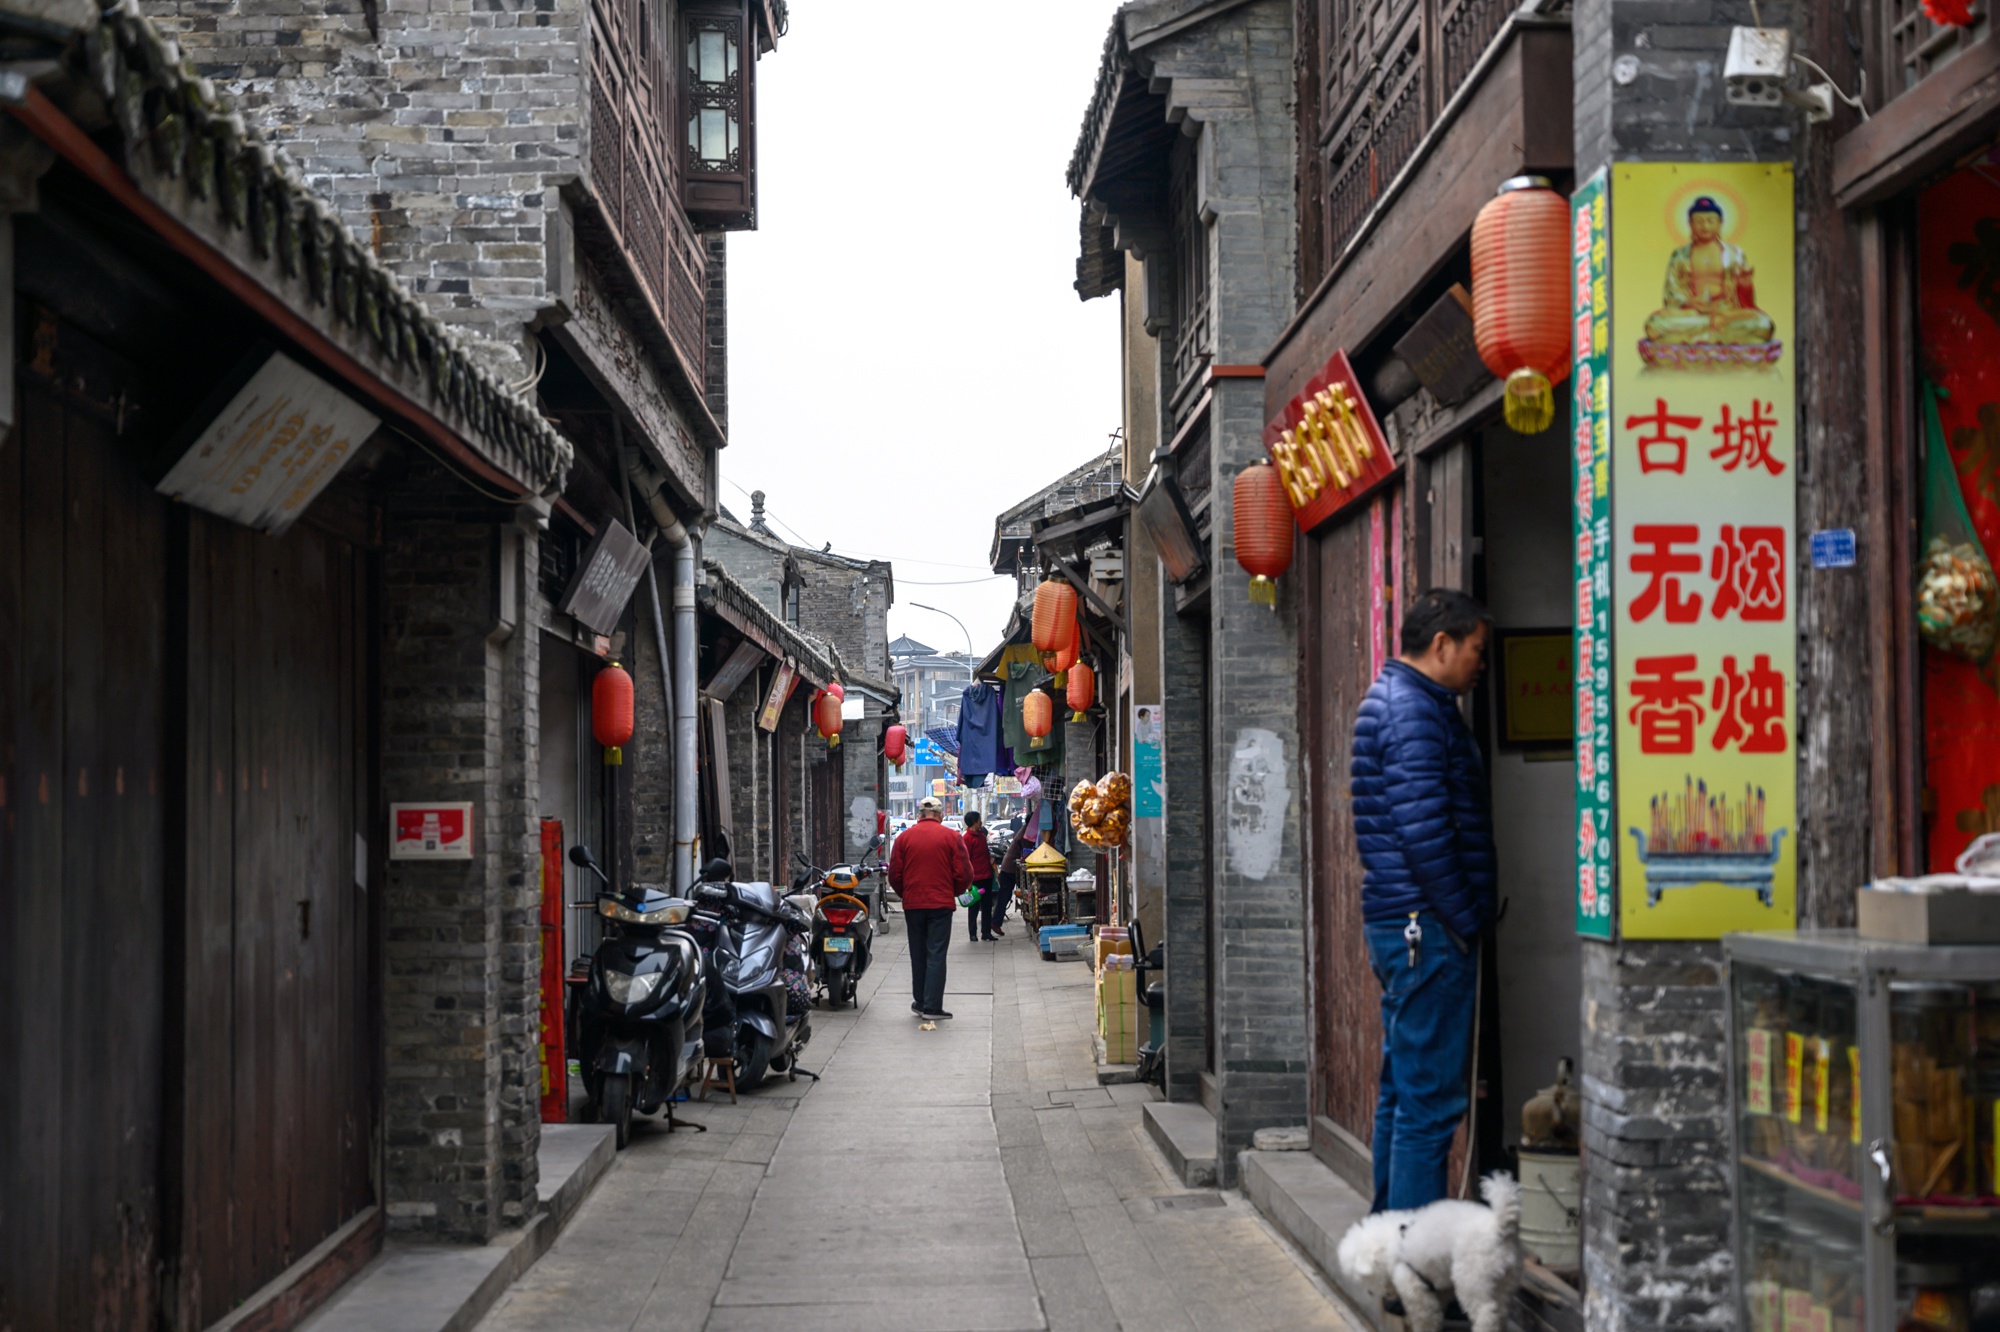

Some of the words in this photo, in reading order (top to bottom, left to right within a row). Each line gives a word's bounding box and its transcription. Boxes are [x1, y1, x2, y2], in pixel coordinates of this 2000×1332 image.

[1626, 398, 1785, 476] 古城
[1594, 516, 1610, 599] 手机
[1630, 525, 1787, 623] 无烟
[1630, 655, 1787, 753] 香烛
[1595, 611, 1610, 916] 15952667056
[1578, 808, 1597, 917] 外科
